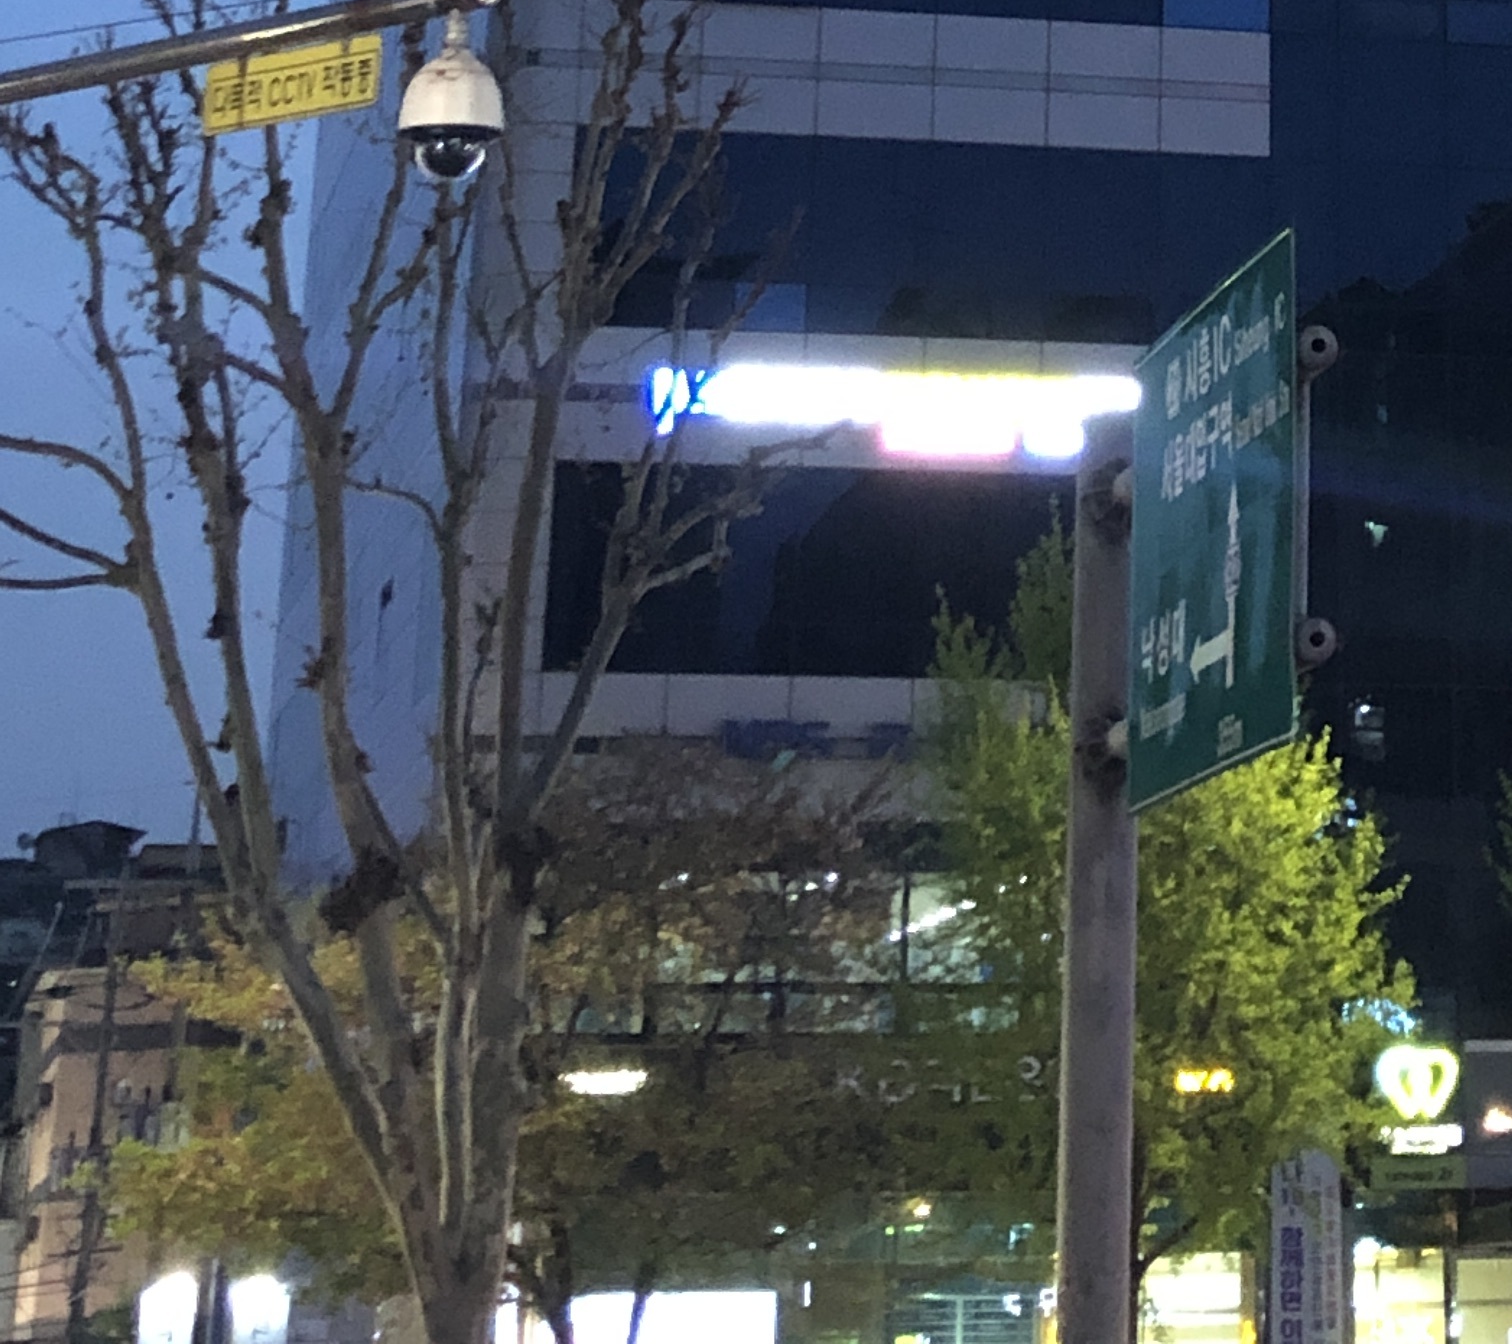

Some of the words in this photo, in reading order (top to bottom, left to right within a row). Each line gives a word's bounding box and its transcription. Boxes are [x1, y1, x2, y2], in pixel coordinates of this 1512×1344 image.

[268, 69, 318, 108] CCTV
[323, 58, 373, 99] 작동중
[1161, 390, 1233, 502] 서울대입구역
[1142, 598, 1186, 684] 낙성대
